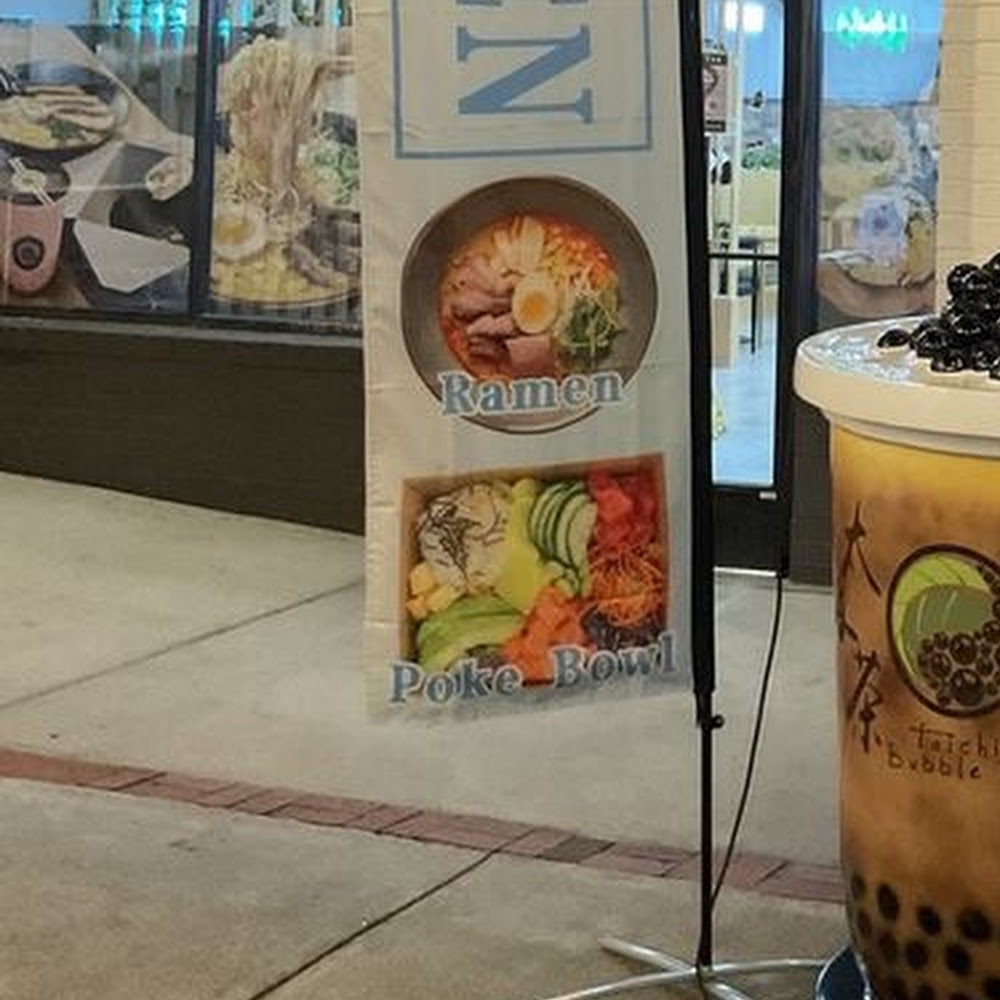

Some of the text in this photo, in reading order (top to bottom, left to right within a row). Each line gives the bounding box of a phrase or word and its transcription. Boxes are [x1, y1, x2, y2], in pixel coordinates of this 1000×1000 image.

[437, 370, 623, 416] Ramen
[389, 631, 678, 705] Poke Bowl
